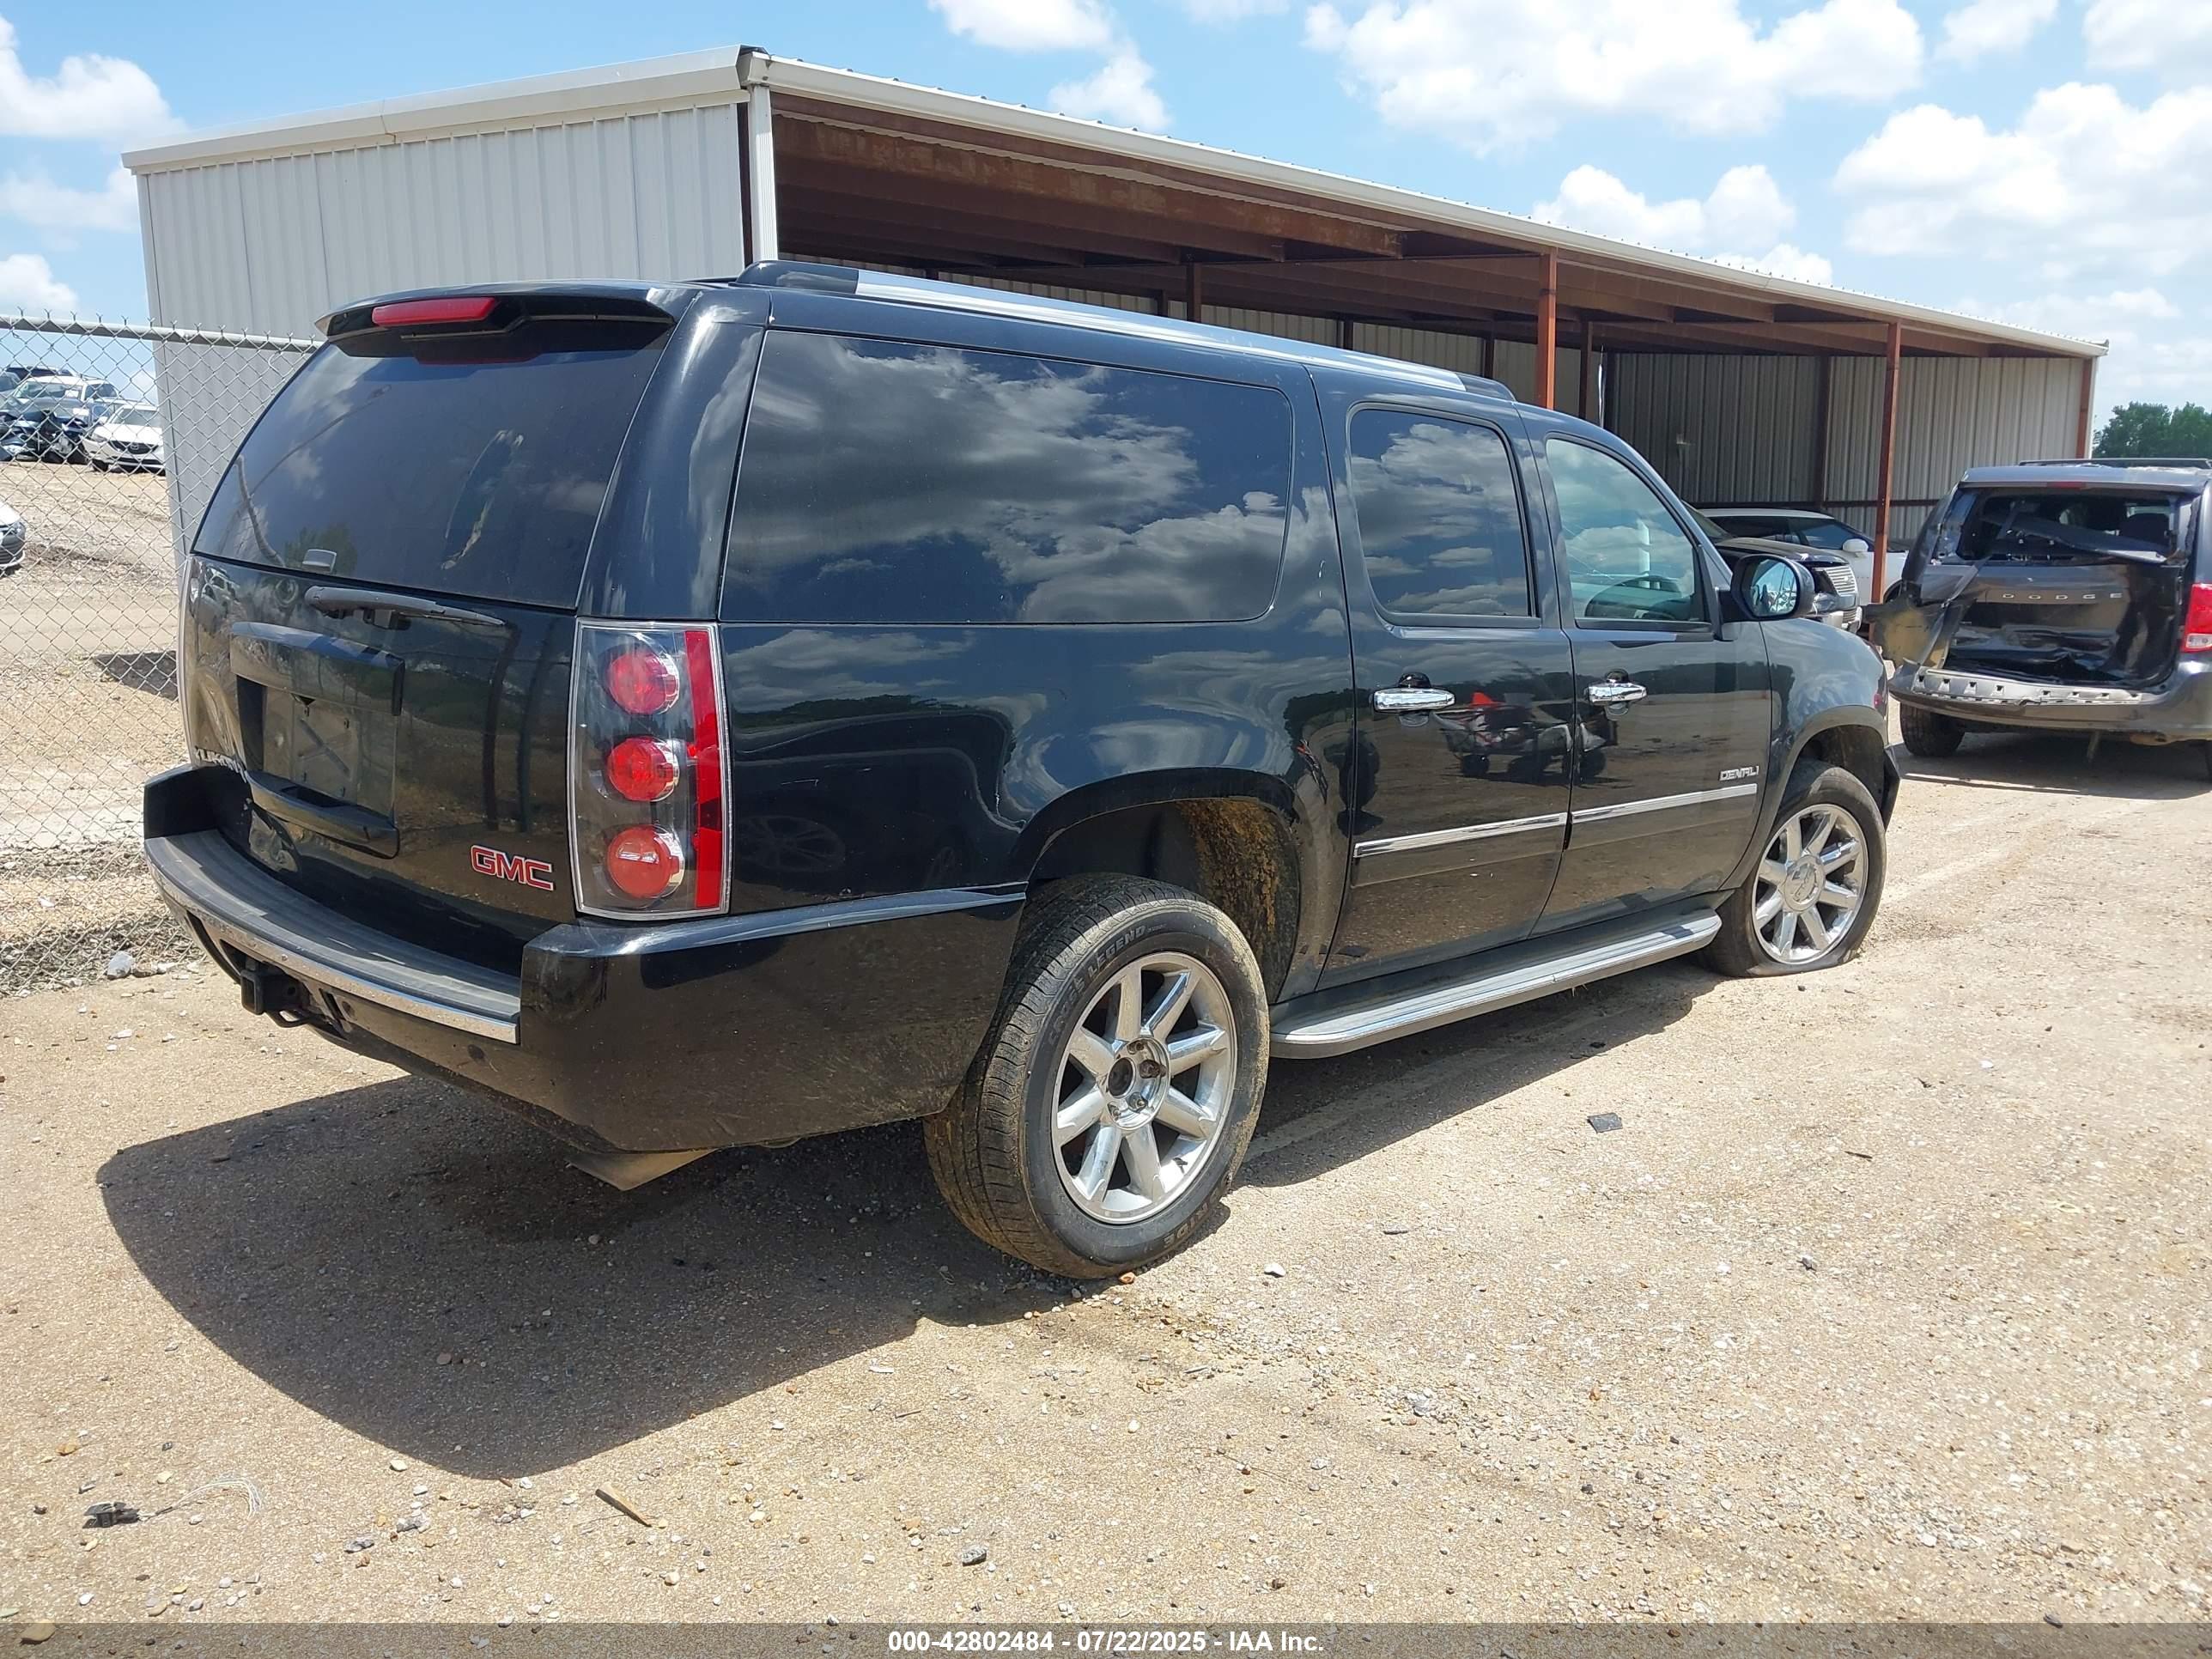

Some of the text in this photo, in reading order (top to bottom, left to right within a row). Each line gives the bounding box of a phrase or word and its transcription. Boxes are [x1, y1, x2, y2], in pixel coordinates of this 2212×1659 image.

[1718, 765, 1759, 781] DENALI
[470, 845, 554, 891] GMC
[1087, 925, 1146, 979] LEGEND
